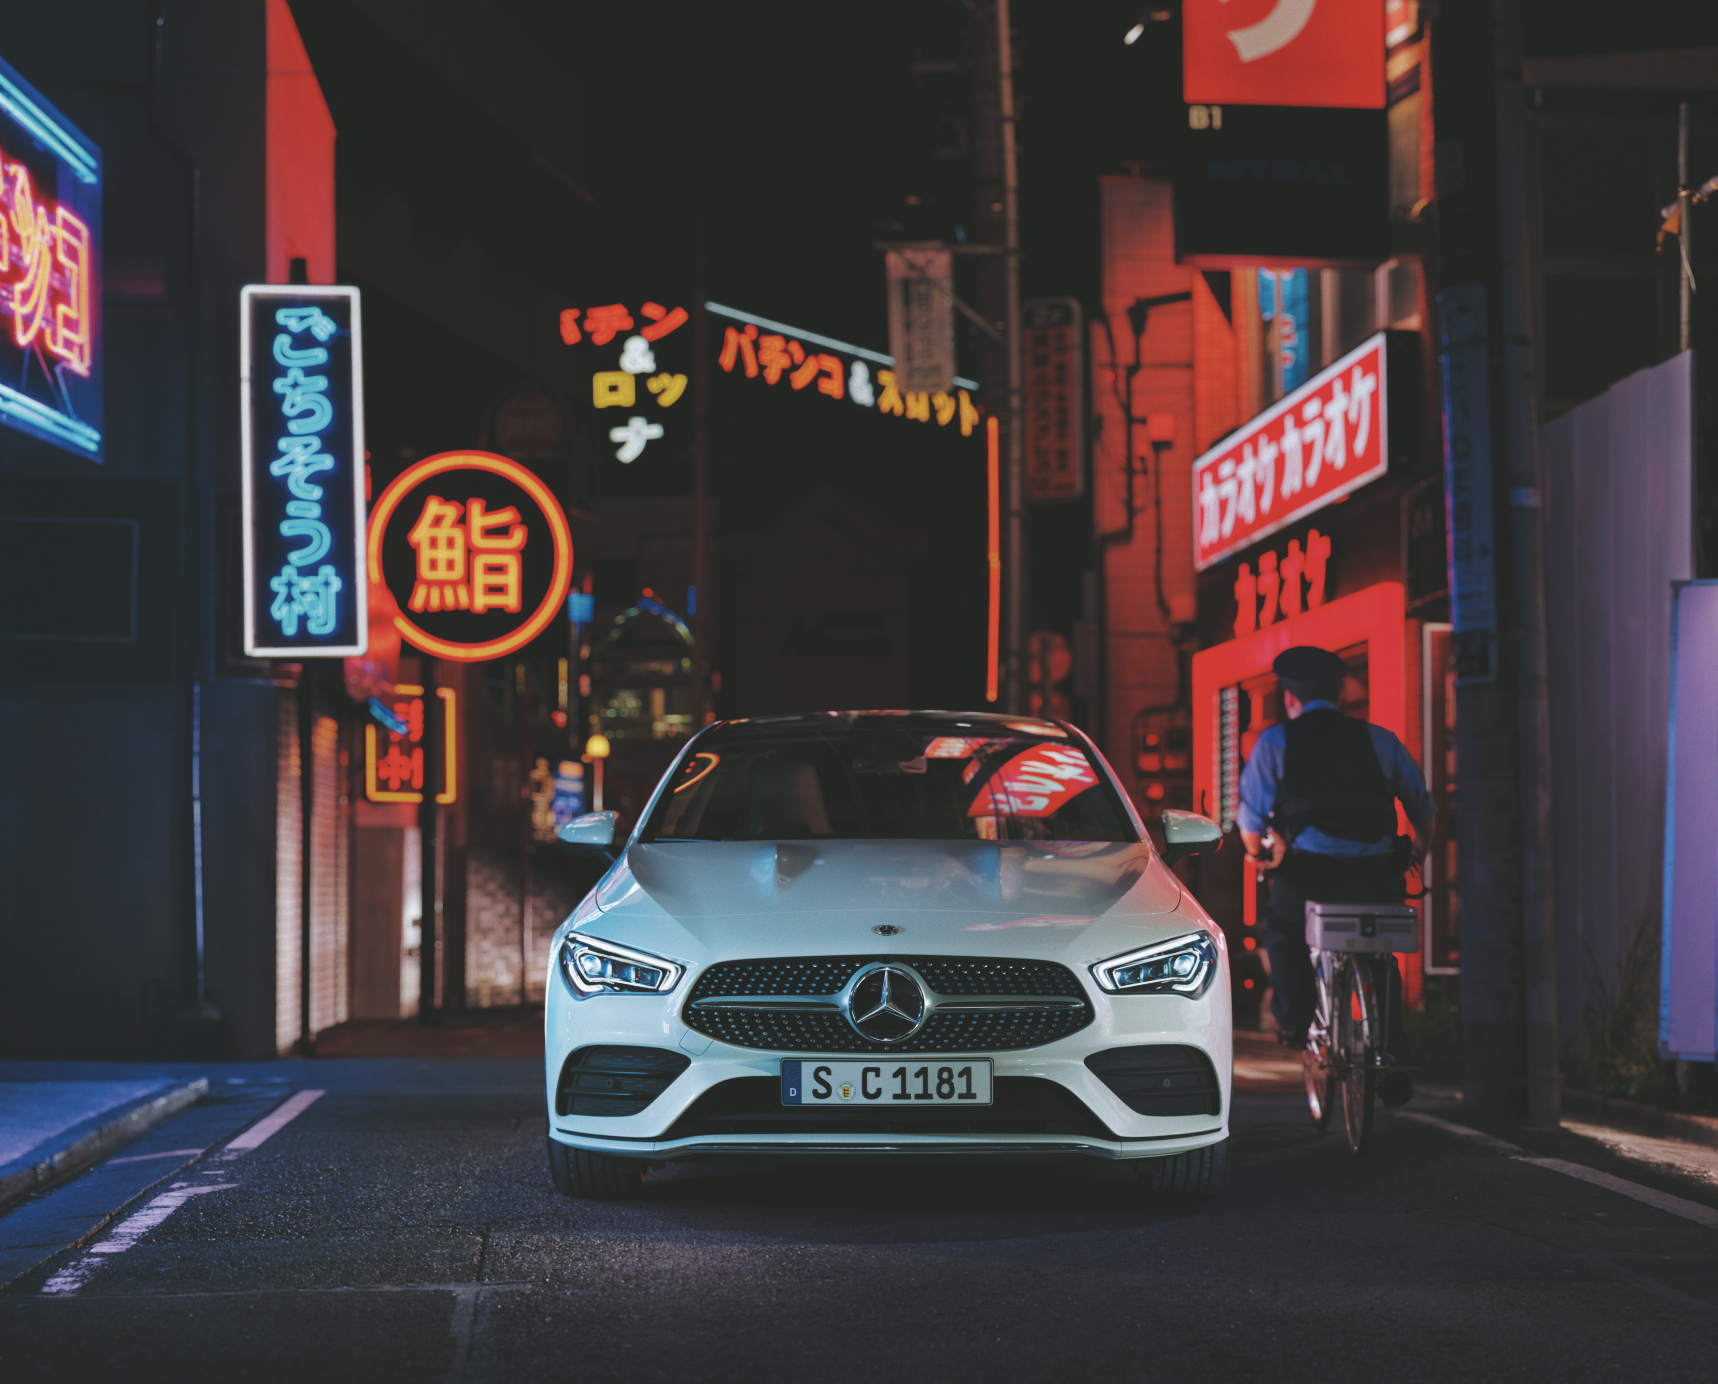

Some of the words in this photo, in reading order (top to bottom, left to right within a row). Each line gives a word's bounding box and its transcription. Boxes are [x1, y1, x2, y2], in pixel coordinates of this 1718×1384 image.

[1188, 105, 1222, 130] B1
[609, 416, 664, 464] ナ
[1200, 365, 1377, 549] カラオケカラオケ
[407, 495, 528, 614] 鮨
[1233, 528, 1331, 638] カラオケ
[789, 1087, 797, 1097] D
